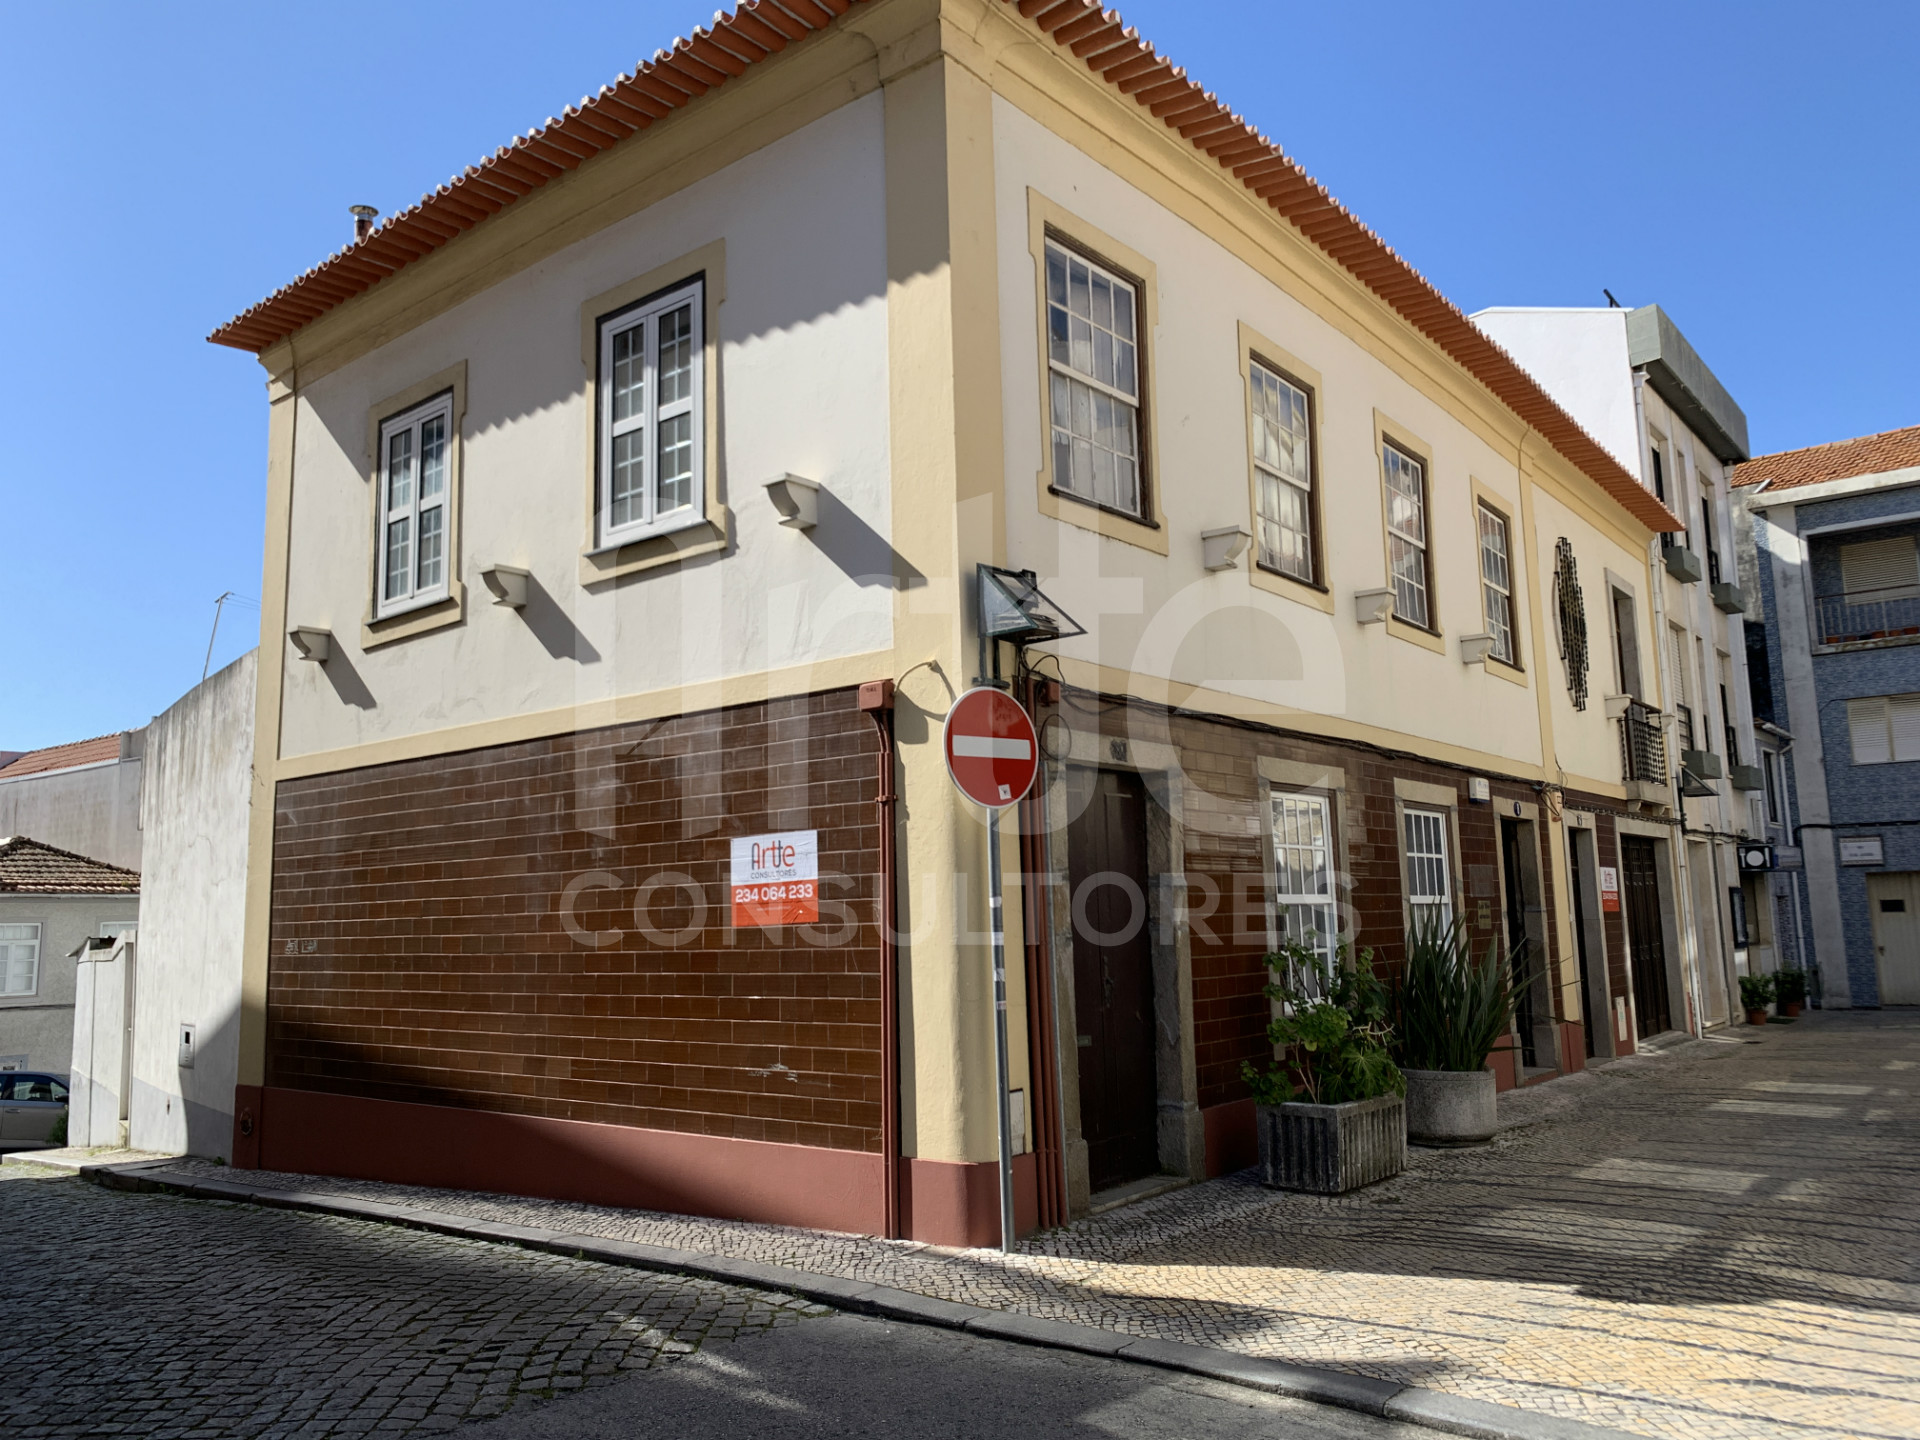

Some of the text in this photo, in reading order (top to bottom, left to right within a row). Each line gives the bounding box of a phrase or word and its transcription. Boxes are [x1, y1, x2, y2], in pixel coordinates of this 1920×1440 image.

[735, 883, 814, 903] 234 064 233
